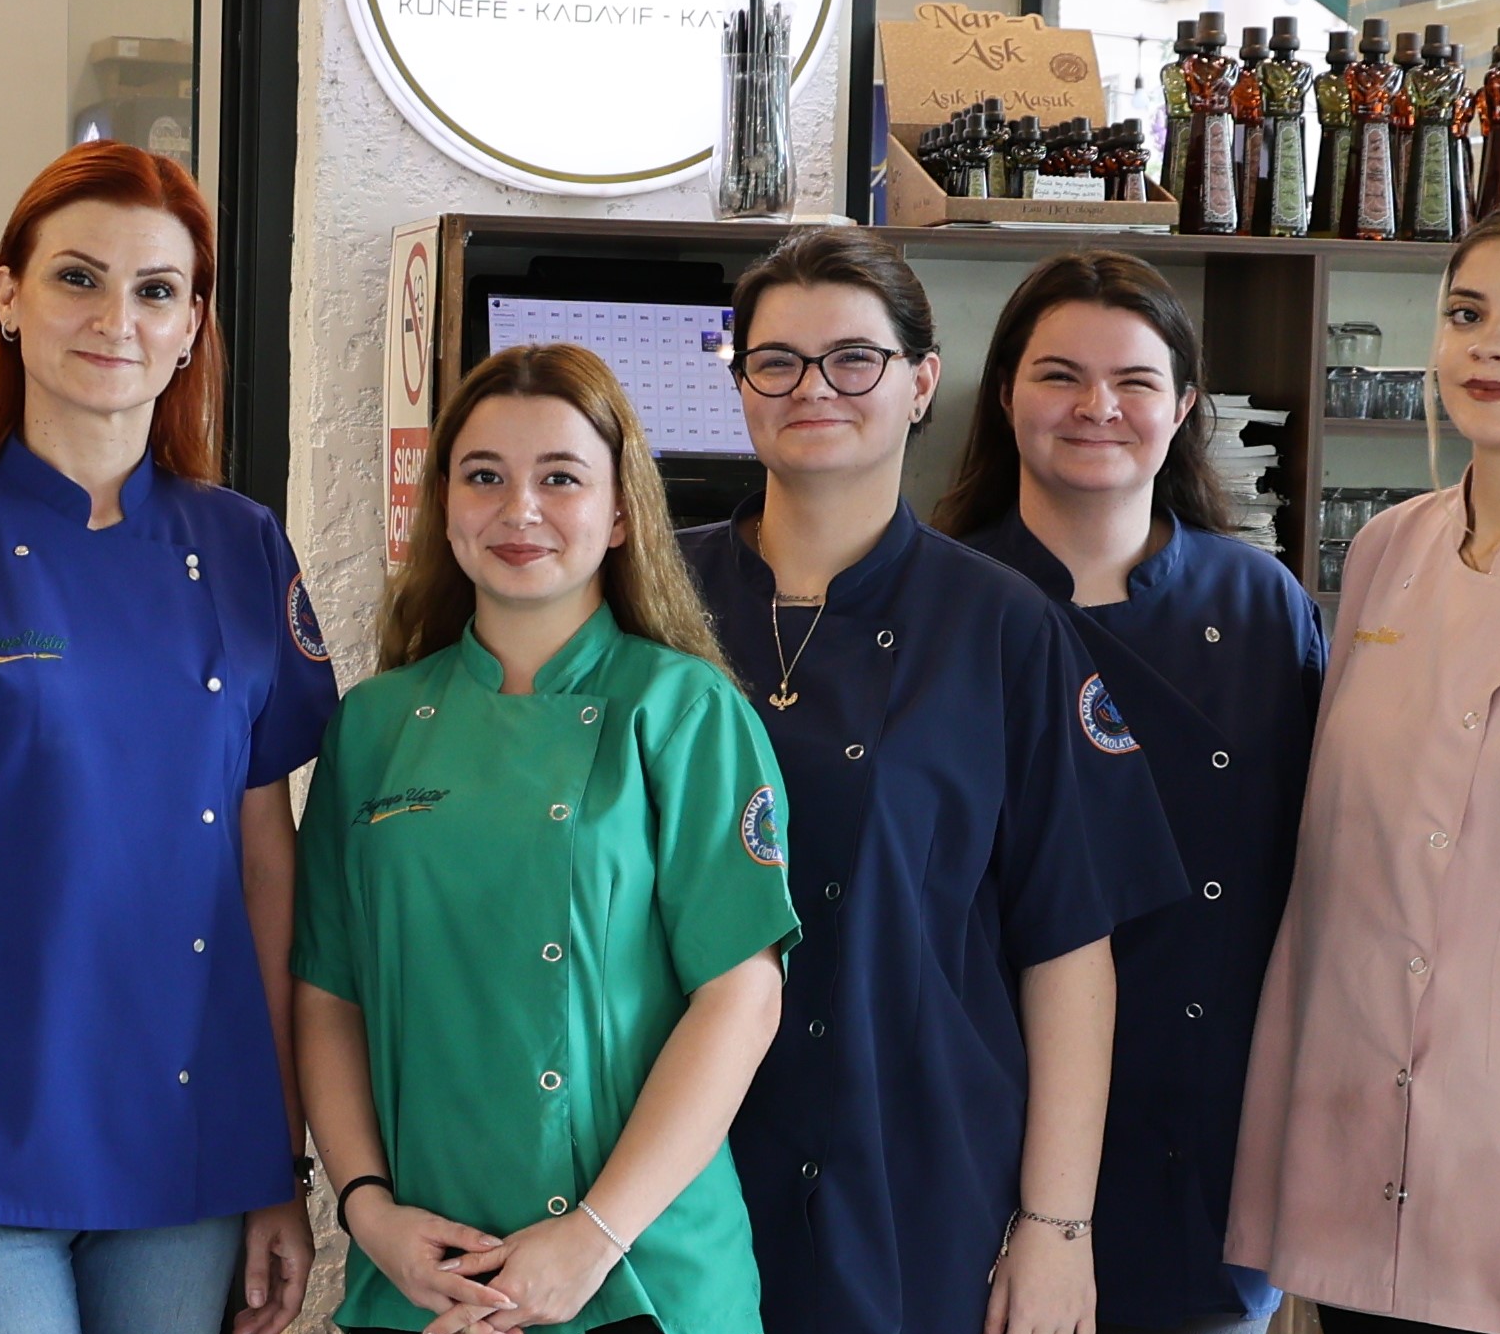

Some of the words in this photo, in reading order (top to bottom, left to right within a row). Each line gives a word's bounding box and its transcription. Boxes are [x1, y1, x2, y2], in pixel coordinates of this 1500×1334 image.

[536, 1, 653, 26] KADAYIF
[952, 37, 1027, 71] Aşk
[920, 89, 968, 109] Aşık
[1003, 89, 1075, 112] Maşuk
[1082, 683, 1098, 721] ADANA
[745, 796, 767, 836] ADANA
